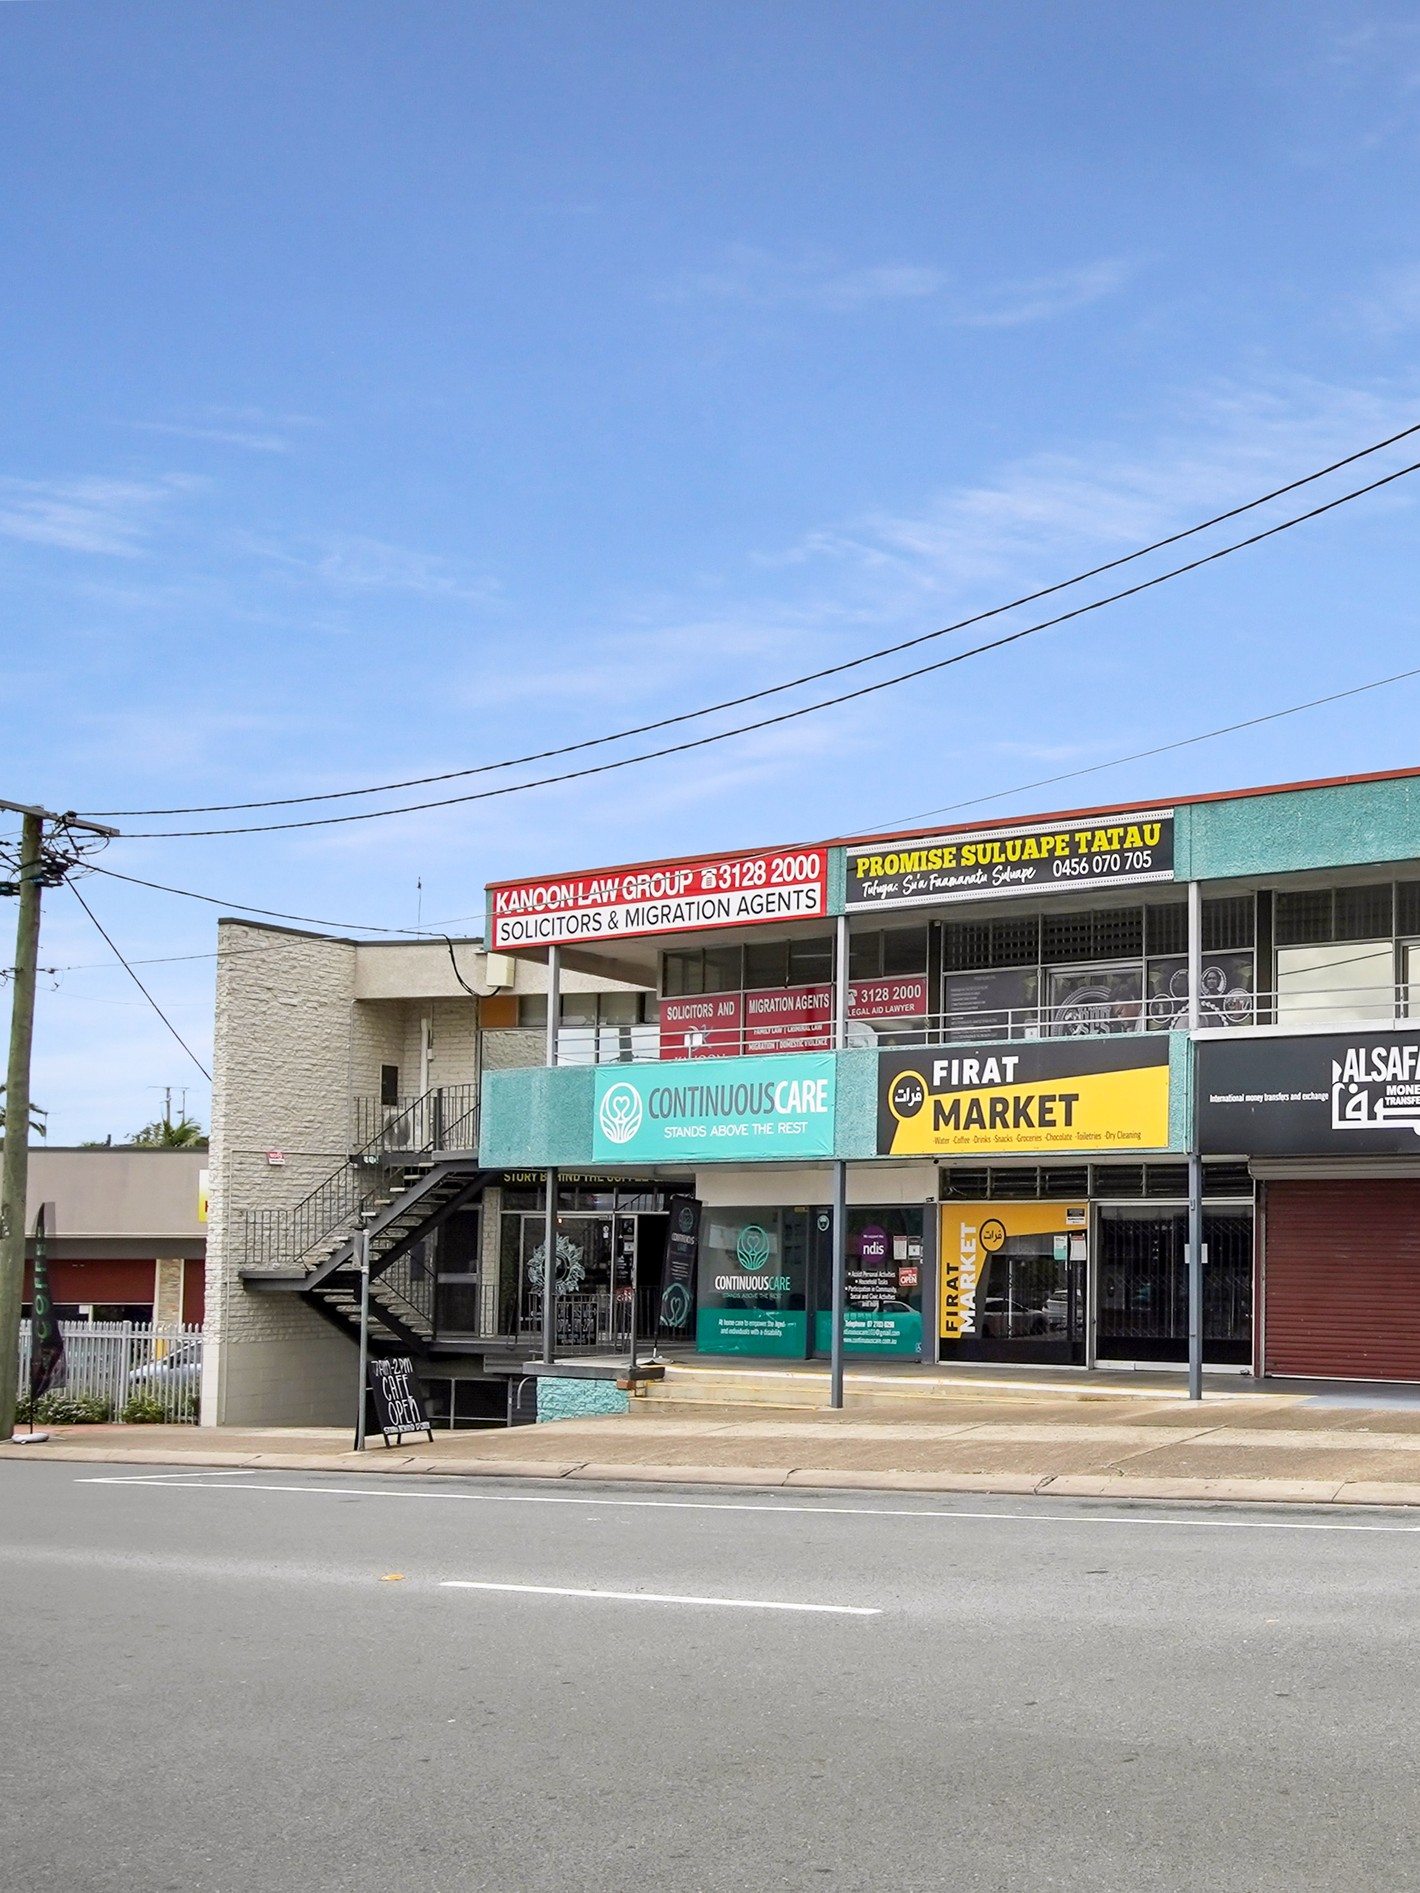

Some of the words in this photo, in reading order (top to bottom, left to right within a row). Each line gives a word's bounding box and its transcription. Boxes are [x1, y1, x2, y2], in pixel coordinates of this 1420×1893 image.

[856, 847, 957, 878] PROMISE
[960, 835, 1070, 867] SULUAPE
[1075, 823, 1161, 854] TATAU
[991, 864, 1037, 886] Suluape
[1053, 858, 1089, 878] 0456
[1092, 854, 1120, 874] 070
[1124, 851, 1152, 870] 705
[496, 883, 574, 915] KANOON
[577, 879, 621, 906] LAW
[623, 869, 694, 900] GROUP
[719, 861, 766, 889] 3128
[770, 854, 820, 882] 2000
[500, 912, 602, 941] SOLICITORS
[608, 912, 619, 930] &
[625, 898, 732, 927] MIGRATION
[736, 888, 817, 916] AGENTS
[667, 1003, 714, 1021] SOLICITORS
[717, 1001, 735, 1016] AND
[748, 997, 794, 1014] MIGRATION
[794, 993, 830, 1010] AGENTS
[861, 987, 889, 1003] 3128
[892, 984, 921, 1000] 2000
[871, 1006, 884, 1014] AID
[885, 1003, 915, 1013] LAWYER
[932, 1056, 1019, 1086] FIRAT
[649, 1078, 829, 1119] CONTINUOUSCARE
[894, 1087, 923, 1107] فرات
[1210, 1093, 1245, 1103] International
[1245, 1095, 1263, 1103] money
[1264, 1093, 1289, 1101] transfers
[1290, 1092, 1301, 1101] and
[1302, 1092, 1329, 1101] exchange
[933, 1093, 1079, 1131] MARKET
[663, 1125, 707, 1139] STANDS
[710, 1124, 749, 1137] ABOVE
[751, 1123, 774, 1135] THE
[777, 1121, 808, 1134] REST
[863, 1242, 885, 1255] ndis
[984, 1230, 1002, 1243] فرات
[715, 1275, 791, 1291] CONTINUOUSCARE
[900, 1274, 917, 1284] OPEN
[960, 1222, 976, 1333] MARKET
[946, 1263, 959, 1332] FIRAT
[382, 1374, 413, 1401] CAFE
[388, 1398, 421, 1426] OPEN
